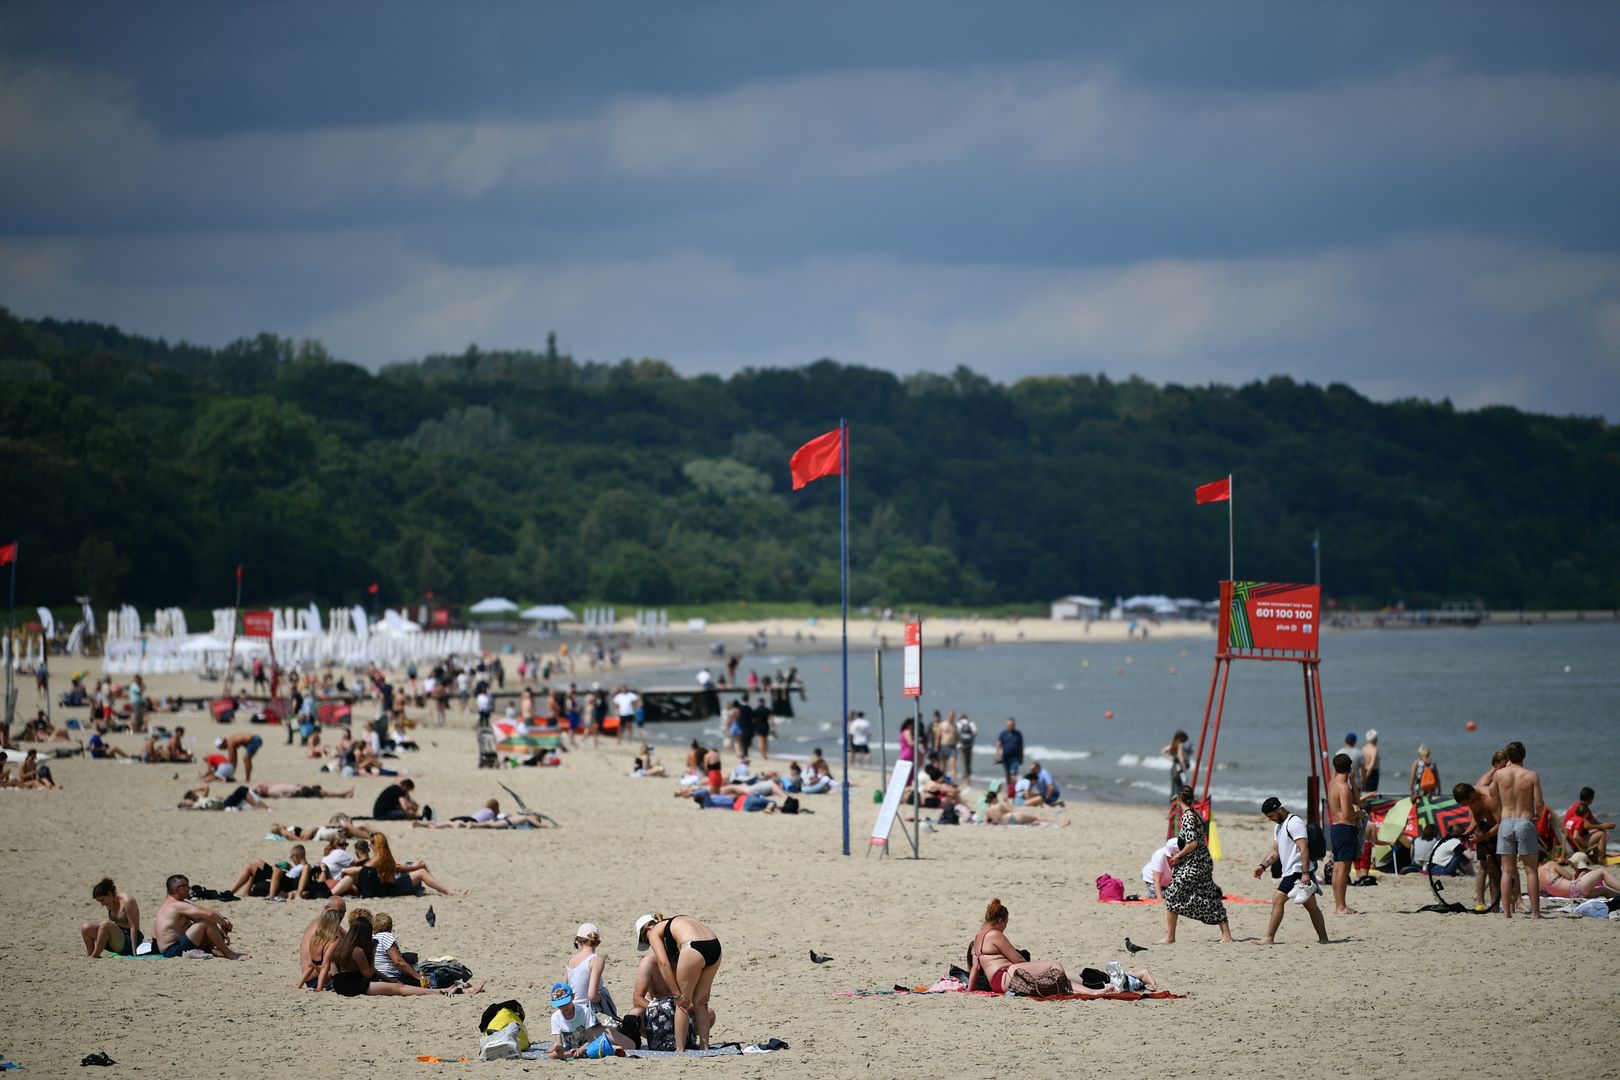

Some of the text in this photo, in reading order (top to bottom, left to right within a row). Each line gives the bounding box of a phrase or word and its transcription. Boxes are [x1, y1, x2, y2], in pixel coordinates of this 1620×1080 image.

[1256, 608, 1312, 619] 601 100 100
